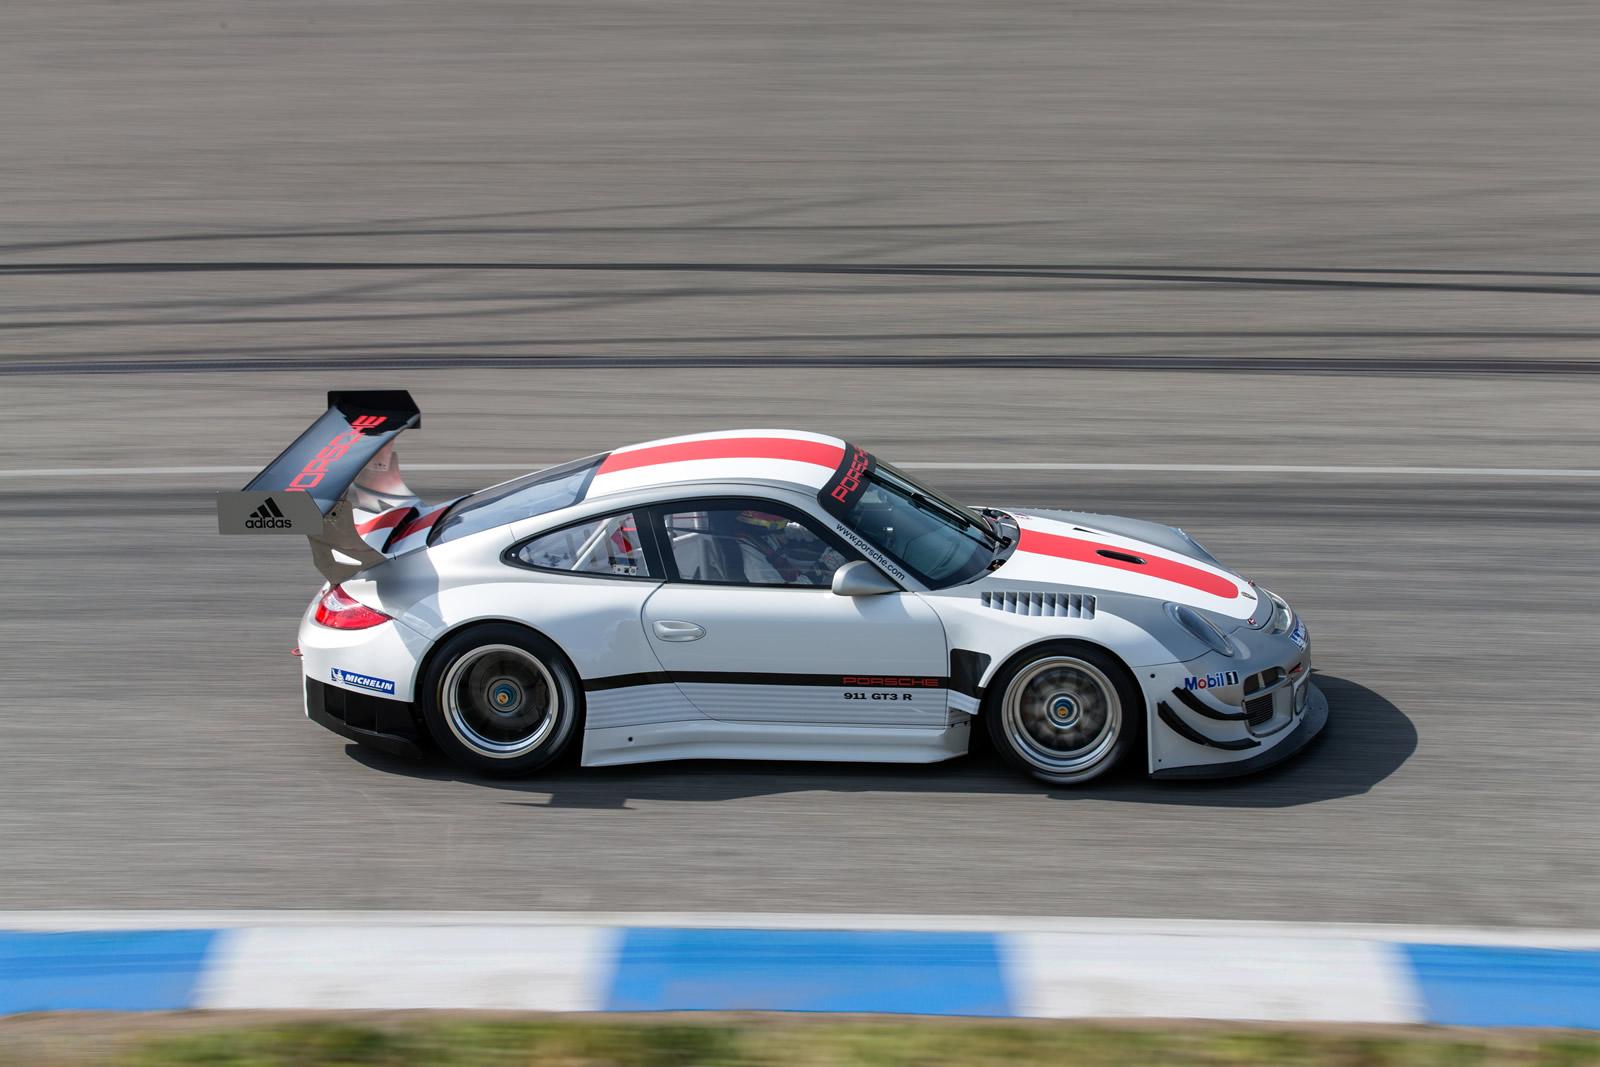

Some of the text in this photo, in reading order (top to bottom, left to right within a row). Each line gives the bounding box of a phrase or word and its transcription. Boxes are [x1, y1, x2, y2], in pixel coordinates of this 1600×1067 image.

[284, 415, 388, 492] ORSCHE
[245, 517, 292, 529] adidas
[836, 523, 905, 581] www.porsche.com
[344, 673, 393, 691] MICHELIN
[842, 677, 940, 687] PORSCHE
[1184, 671, 1237, 691] Mobil 1
[844, 692, 913, 701] 911 GT3 R
